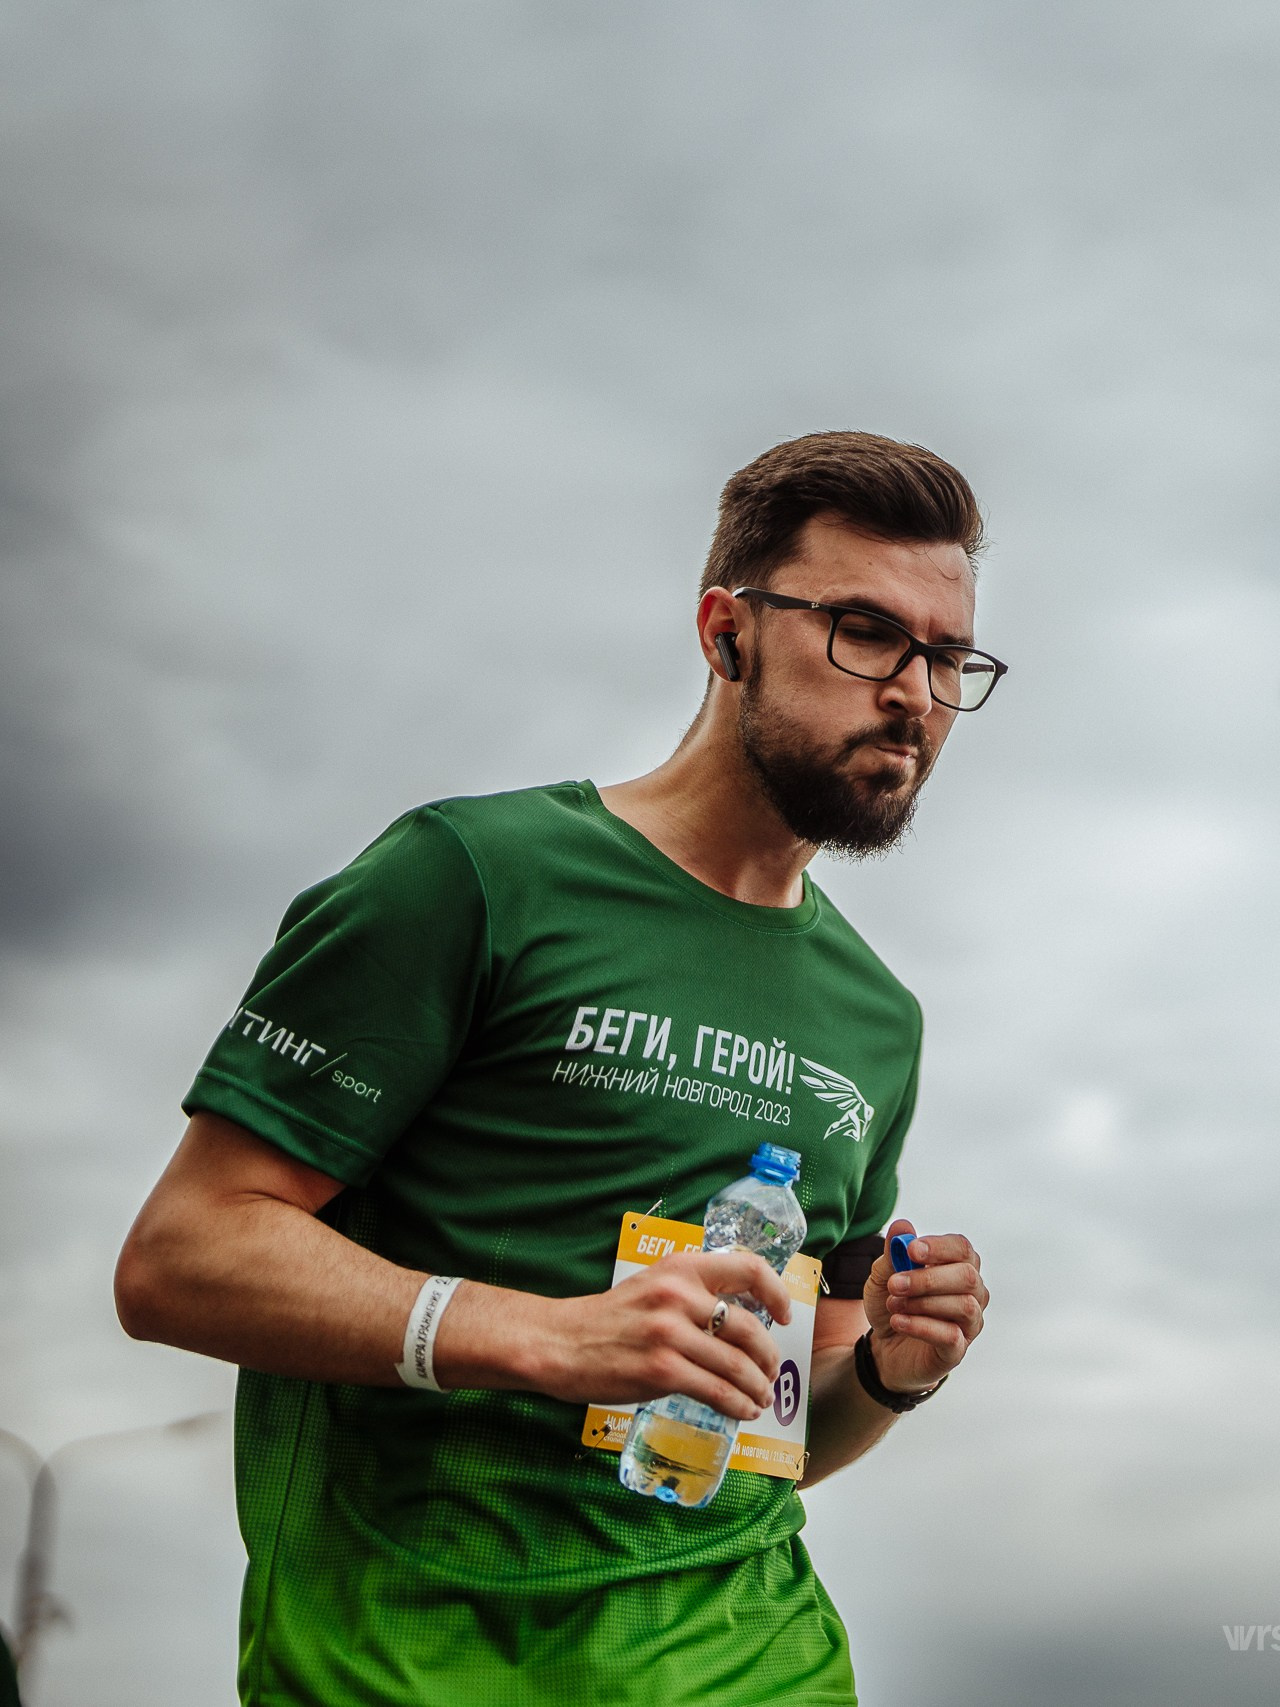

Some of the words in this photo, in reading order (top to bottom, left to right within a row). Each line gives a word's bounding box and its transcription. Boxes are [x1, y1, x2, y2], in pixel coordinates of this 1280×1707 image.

[565, 1006, 677, 1070] БЕГИ,
[693, 1025, 795, 1094] ГЕРОЙ!
[332, 1070, 382, 1103] sport
[552, 1061, 658, 1095] НИЖНИЙ
[663, 1075, 752, 1121] НОВГОРОД
[754, 1099, 791, 1126] 2023
[780, 1371, 795, 1418] B
[742, 1445, 769, 1461] НОВГОРОД
